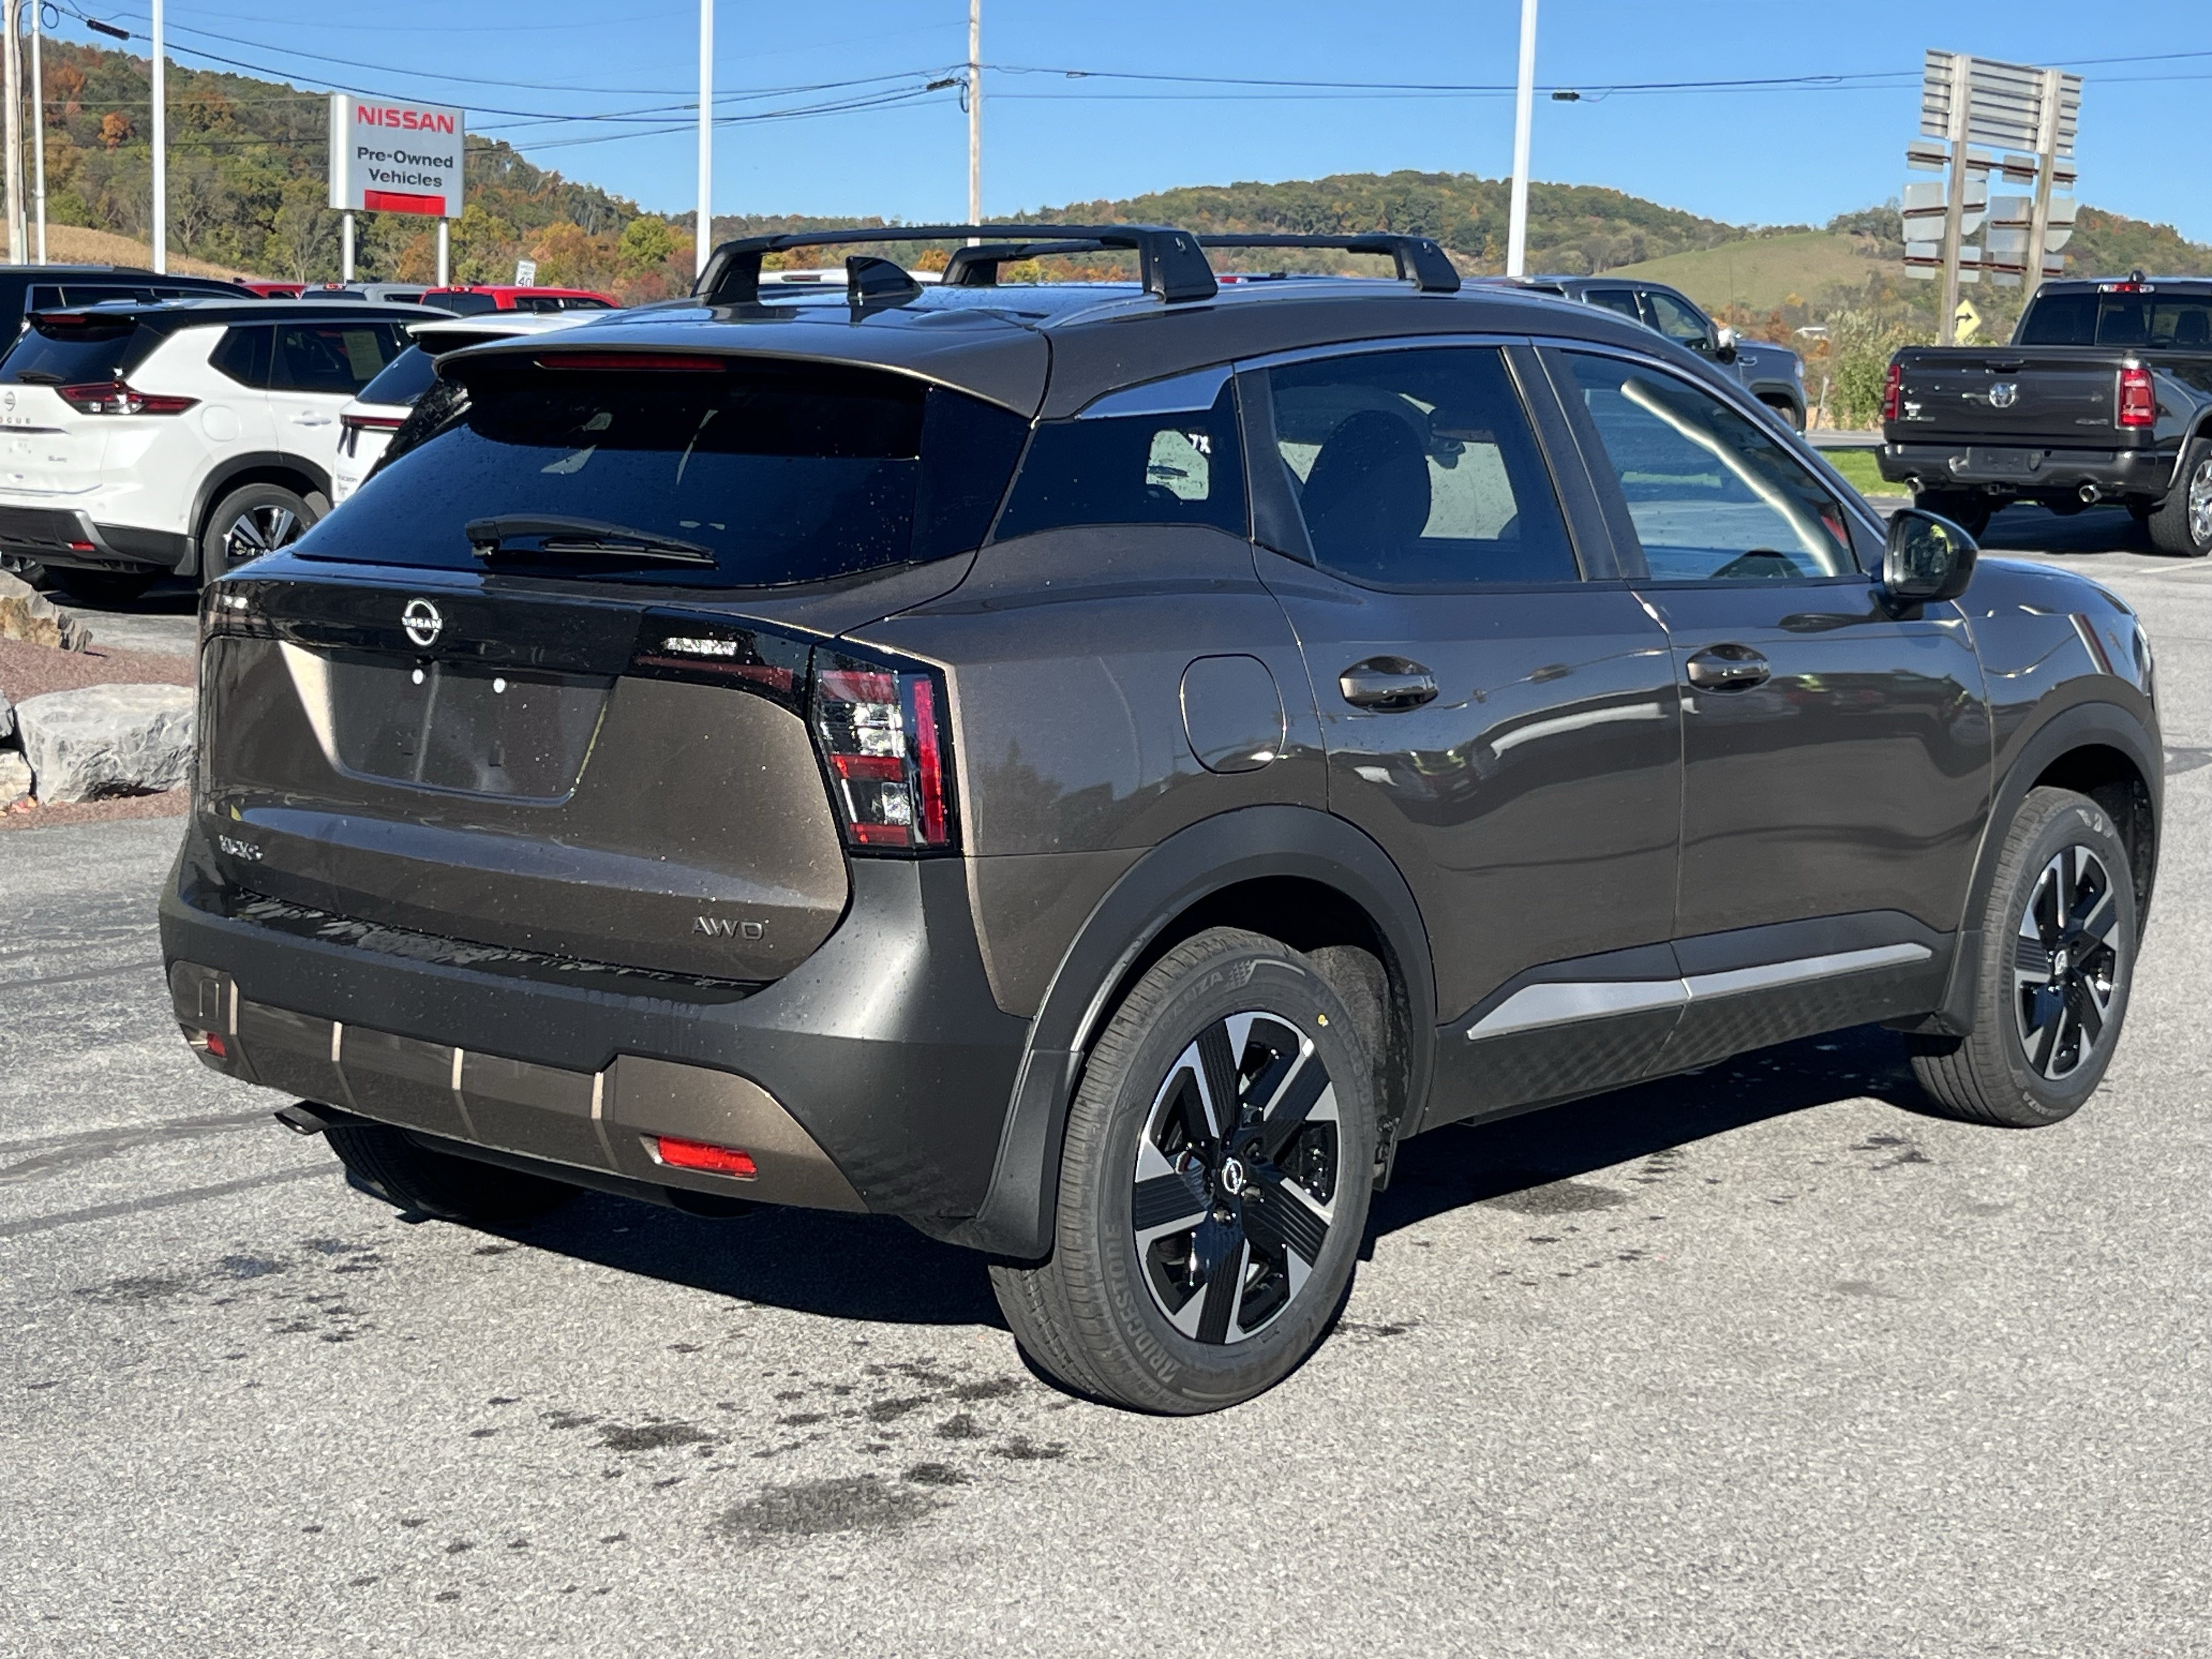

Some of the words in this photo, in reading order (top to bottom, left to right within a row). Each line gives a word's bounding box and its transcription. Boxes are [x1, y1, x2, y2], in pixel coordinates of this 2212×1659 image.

[358, 105, 454, 134] NISSAN
[357, 146, 454, 168] Pre-Owned
[368, 167, 443, 188] Vehicles
[517, 276, 533, 287] 40
[402, 616, 443, 629] NISSAN
[692, 916, 764, 941] AWD
[1105, 1223, 1182, 1383] BRIDGESTONE
